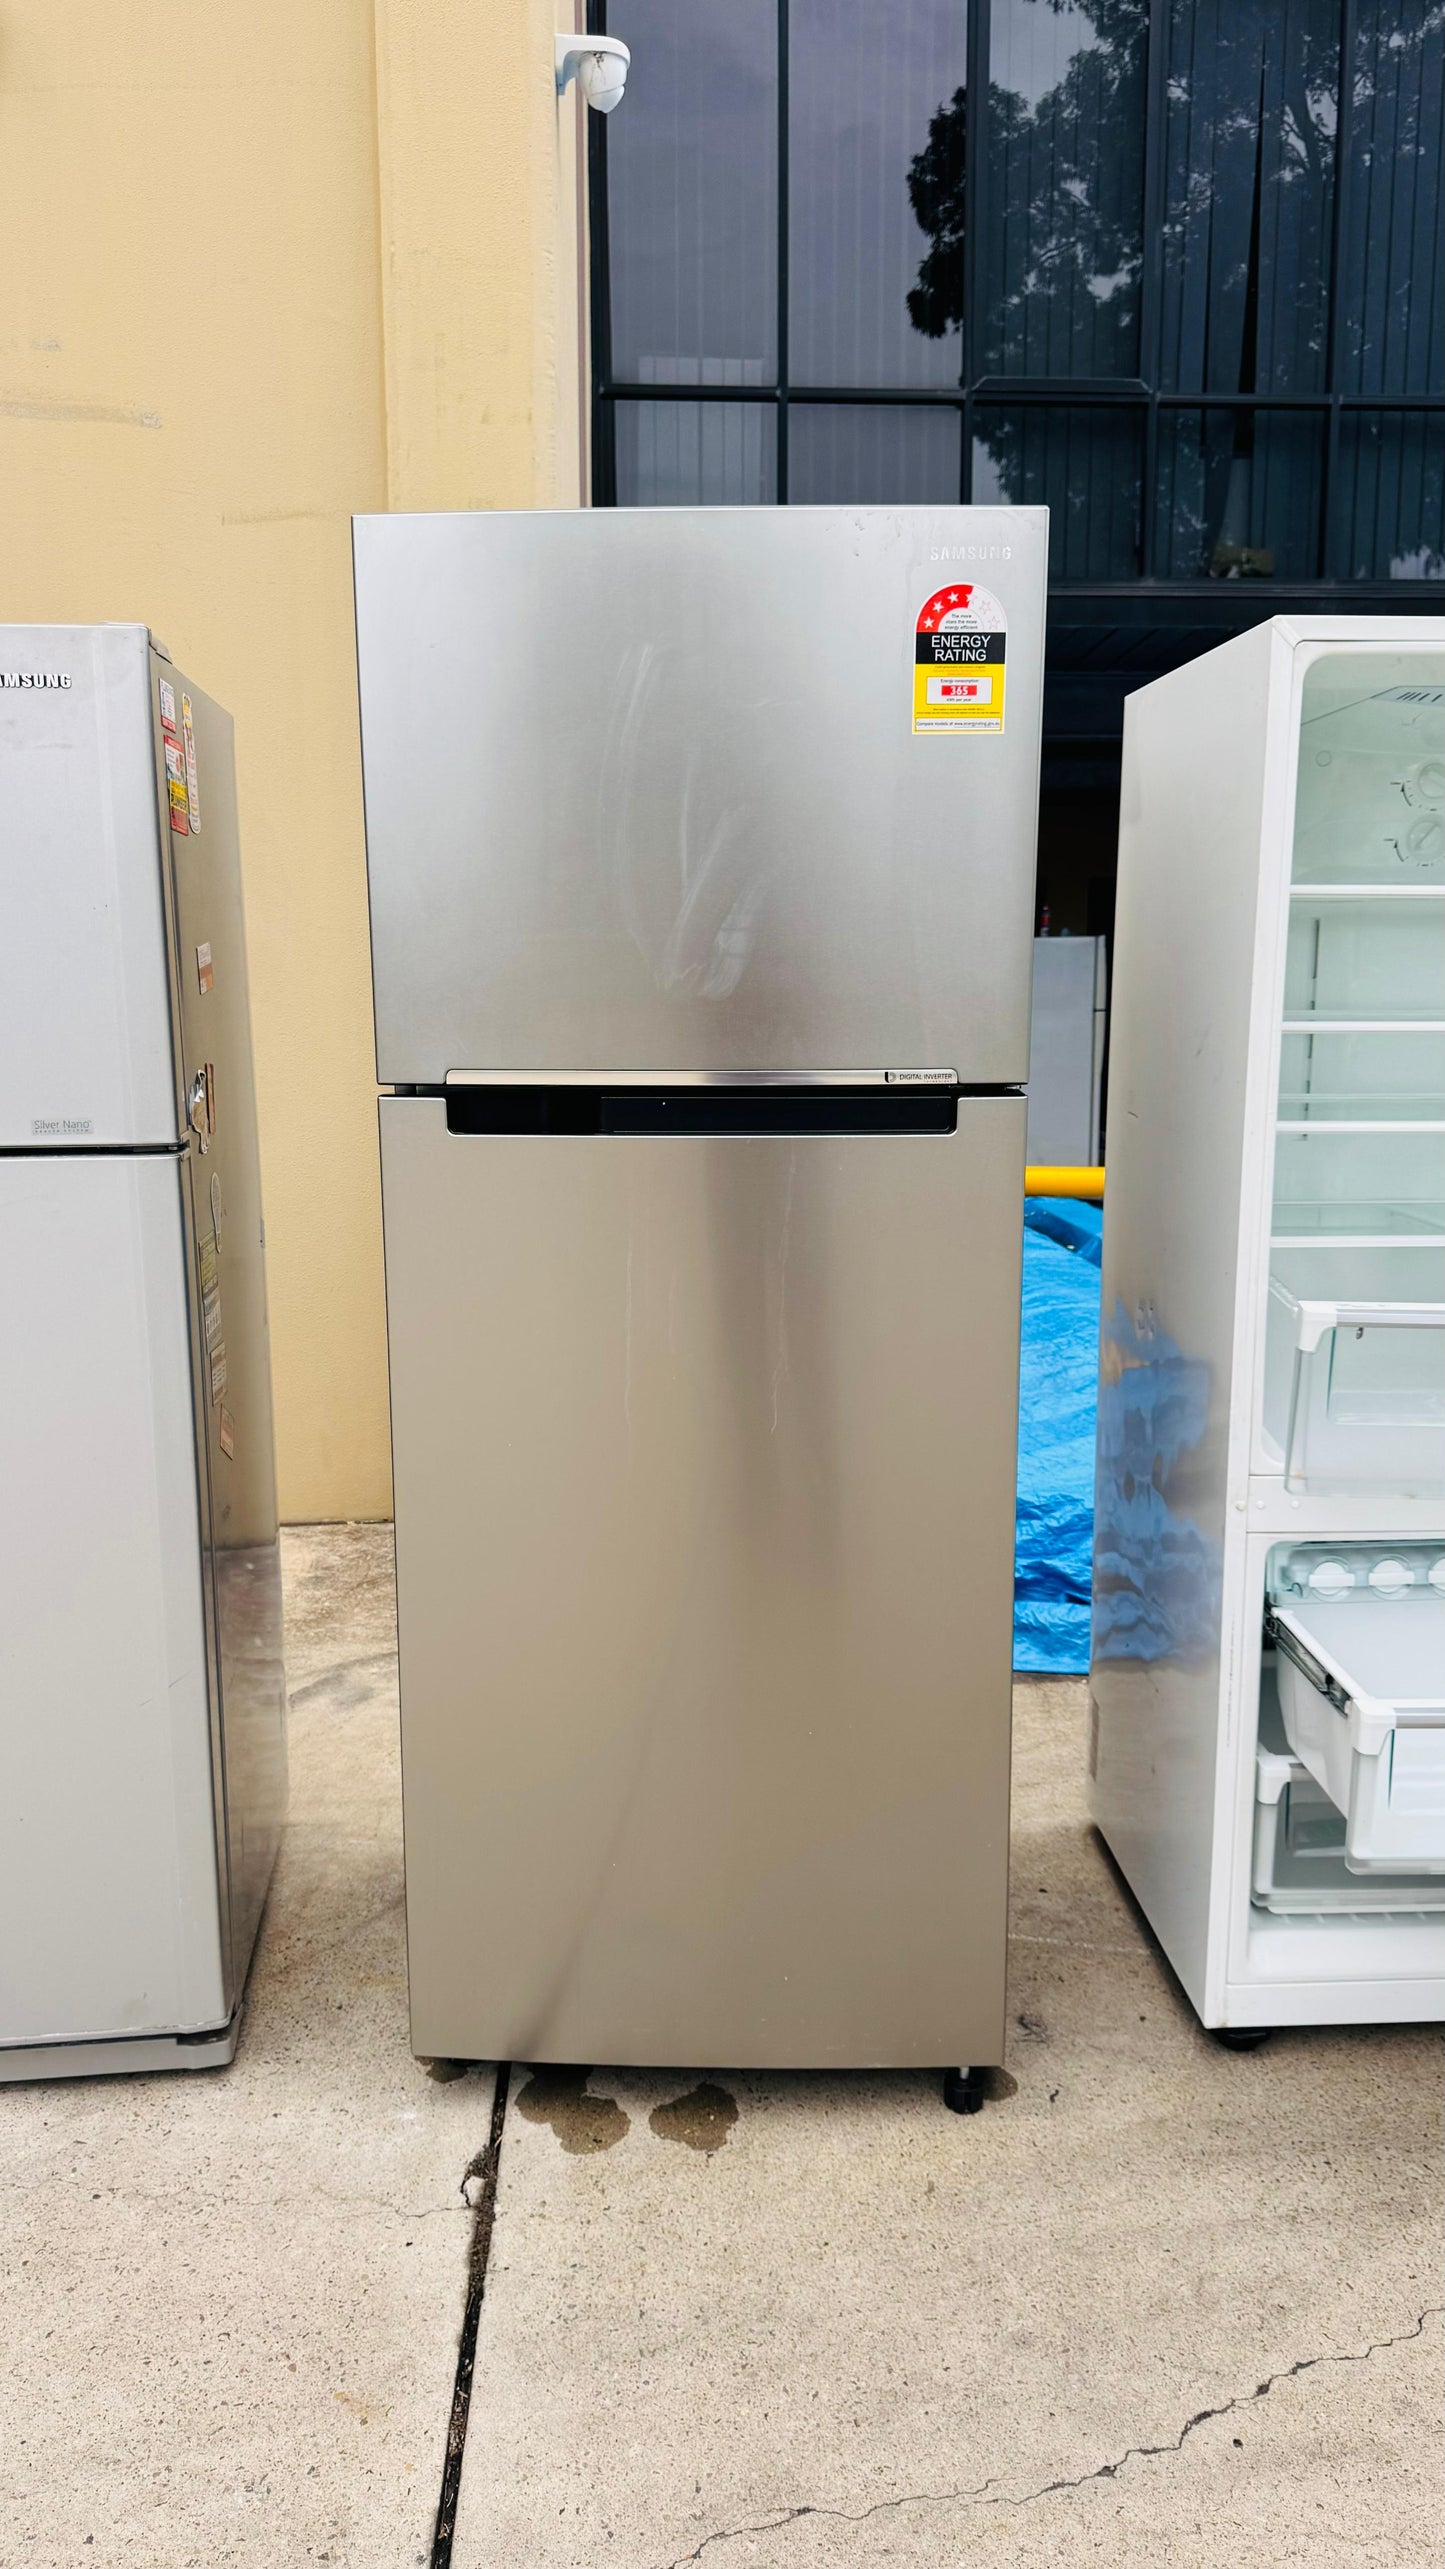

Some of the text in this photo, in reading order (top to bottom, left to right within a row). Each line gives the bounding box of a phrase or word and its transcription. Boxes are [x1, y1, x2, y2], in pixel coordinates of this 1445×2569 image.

[930, 546, 1012, 560] SAMSUNG
[931, 635, 991, 648] ENERGY
[934, 649, 987, 662] RATING
[950, 686, 969, 695] 365
[899, 1073, 922, 1081] DIGITAL
[34, 1120, 59, 1129] Silver
